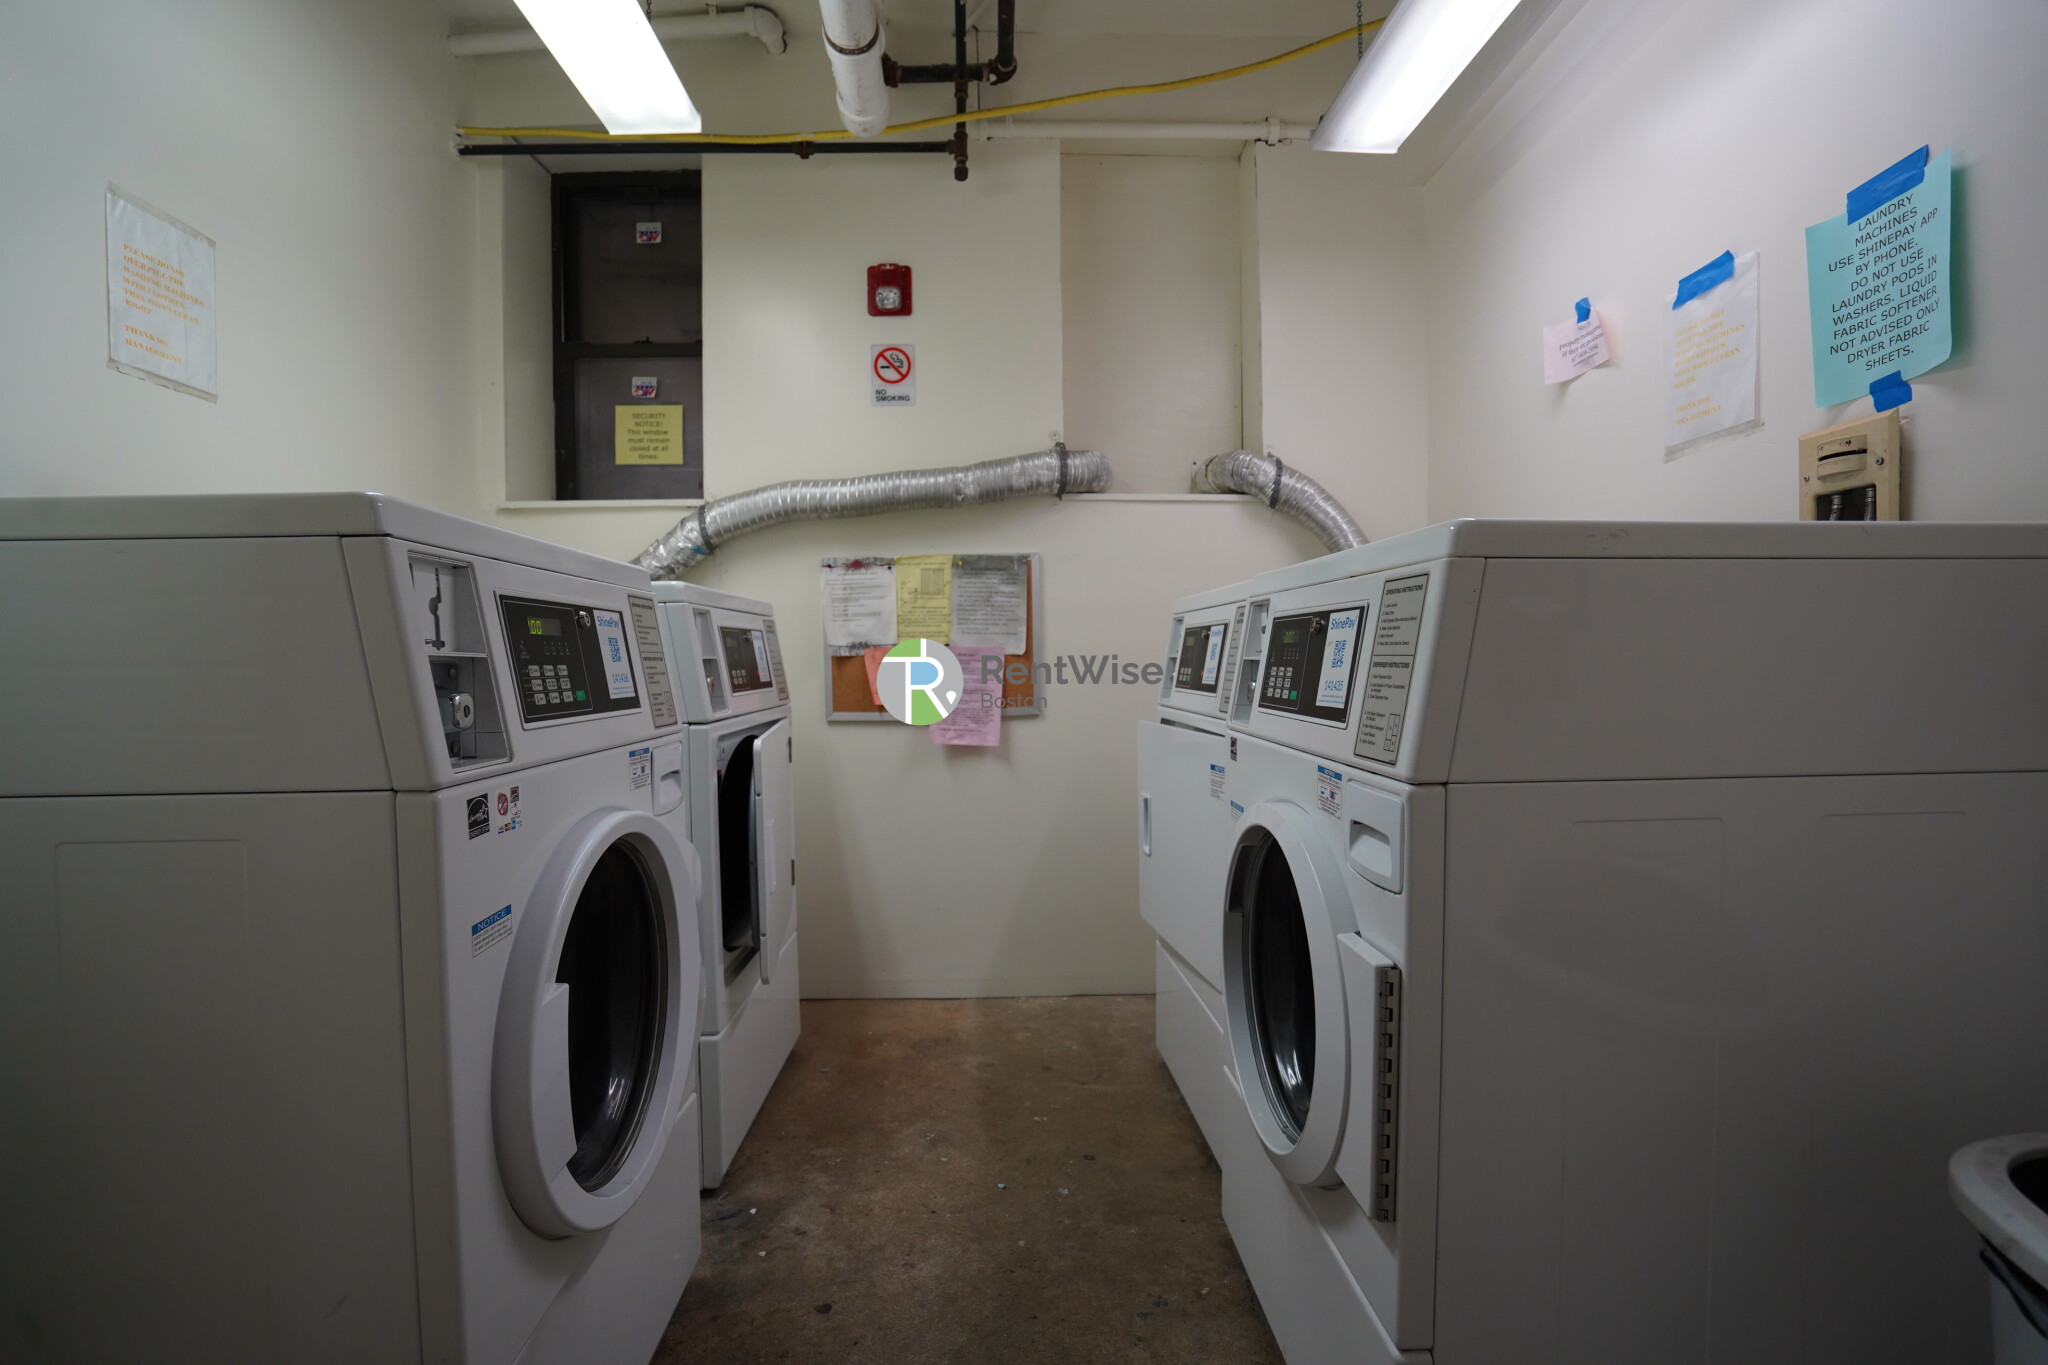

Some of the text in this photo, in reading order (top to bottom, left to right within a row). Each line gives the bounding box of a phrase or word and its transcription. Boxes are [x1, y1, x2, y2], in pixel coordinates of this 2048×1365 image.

[1858, 194, 1913, 231] LAUNDRY
[1828, 207, 1937, 272] USE SHINEPAY APP
[1855, 207, 1917, 247] MACHINES
[123, 243, 152, 261] PLEASE
[157, 260, 168, 269] DO
[1855, 237, 1917, 275] BY PHONE.
[169, 276, 184, 287] THE
[1851, 248, 1923, 291] DO NOT USE
[123, 276, 145, 291] WITH
[123, 265, 203, 306] WASHING MACHINES
[1832, 255, 1937, 312] LAUNDRY PODS IN
[124, 288, 144, 301] THEY
[172, 310, 199, 324] CLEAN
[1832, 270, 1937, 326] WASHERS. LIQUID
[1833, 286, 1937, 339] FABRIC SOFTENER
[124, 324, 155, 340] THANK
[1705, 323, 1744, 342] MACHINES
[1830, 298, 1939, 355] NOT ADVISED ONLY
[124, 338, 182, 363] MANAGEMENT
[1562, 349, 1568, 357] if
[1714, 346, 1741, 362] CLEAN
[1847, 321, 1930, 363] DRYER FABRIC
[1865, 344, 1913, 370] SHEETS.
[1675, 404, 1721, 425] MANAGEMENT
[1676, 400, 1696, 413] THANK
[1330, 615, 1356, 632] ShinePay
[1324, 680, 1344, 692] 141435
[477, 908, 507, 931] NOTICE
